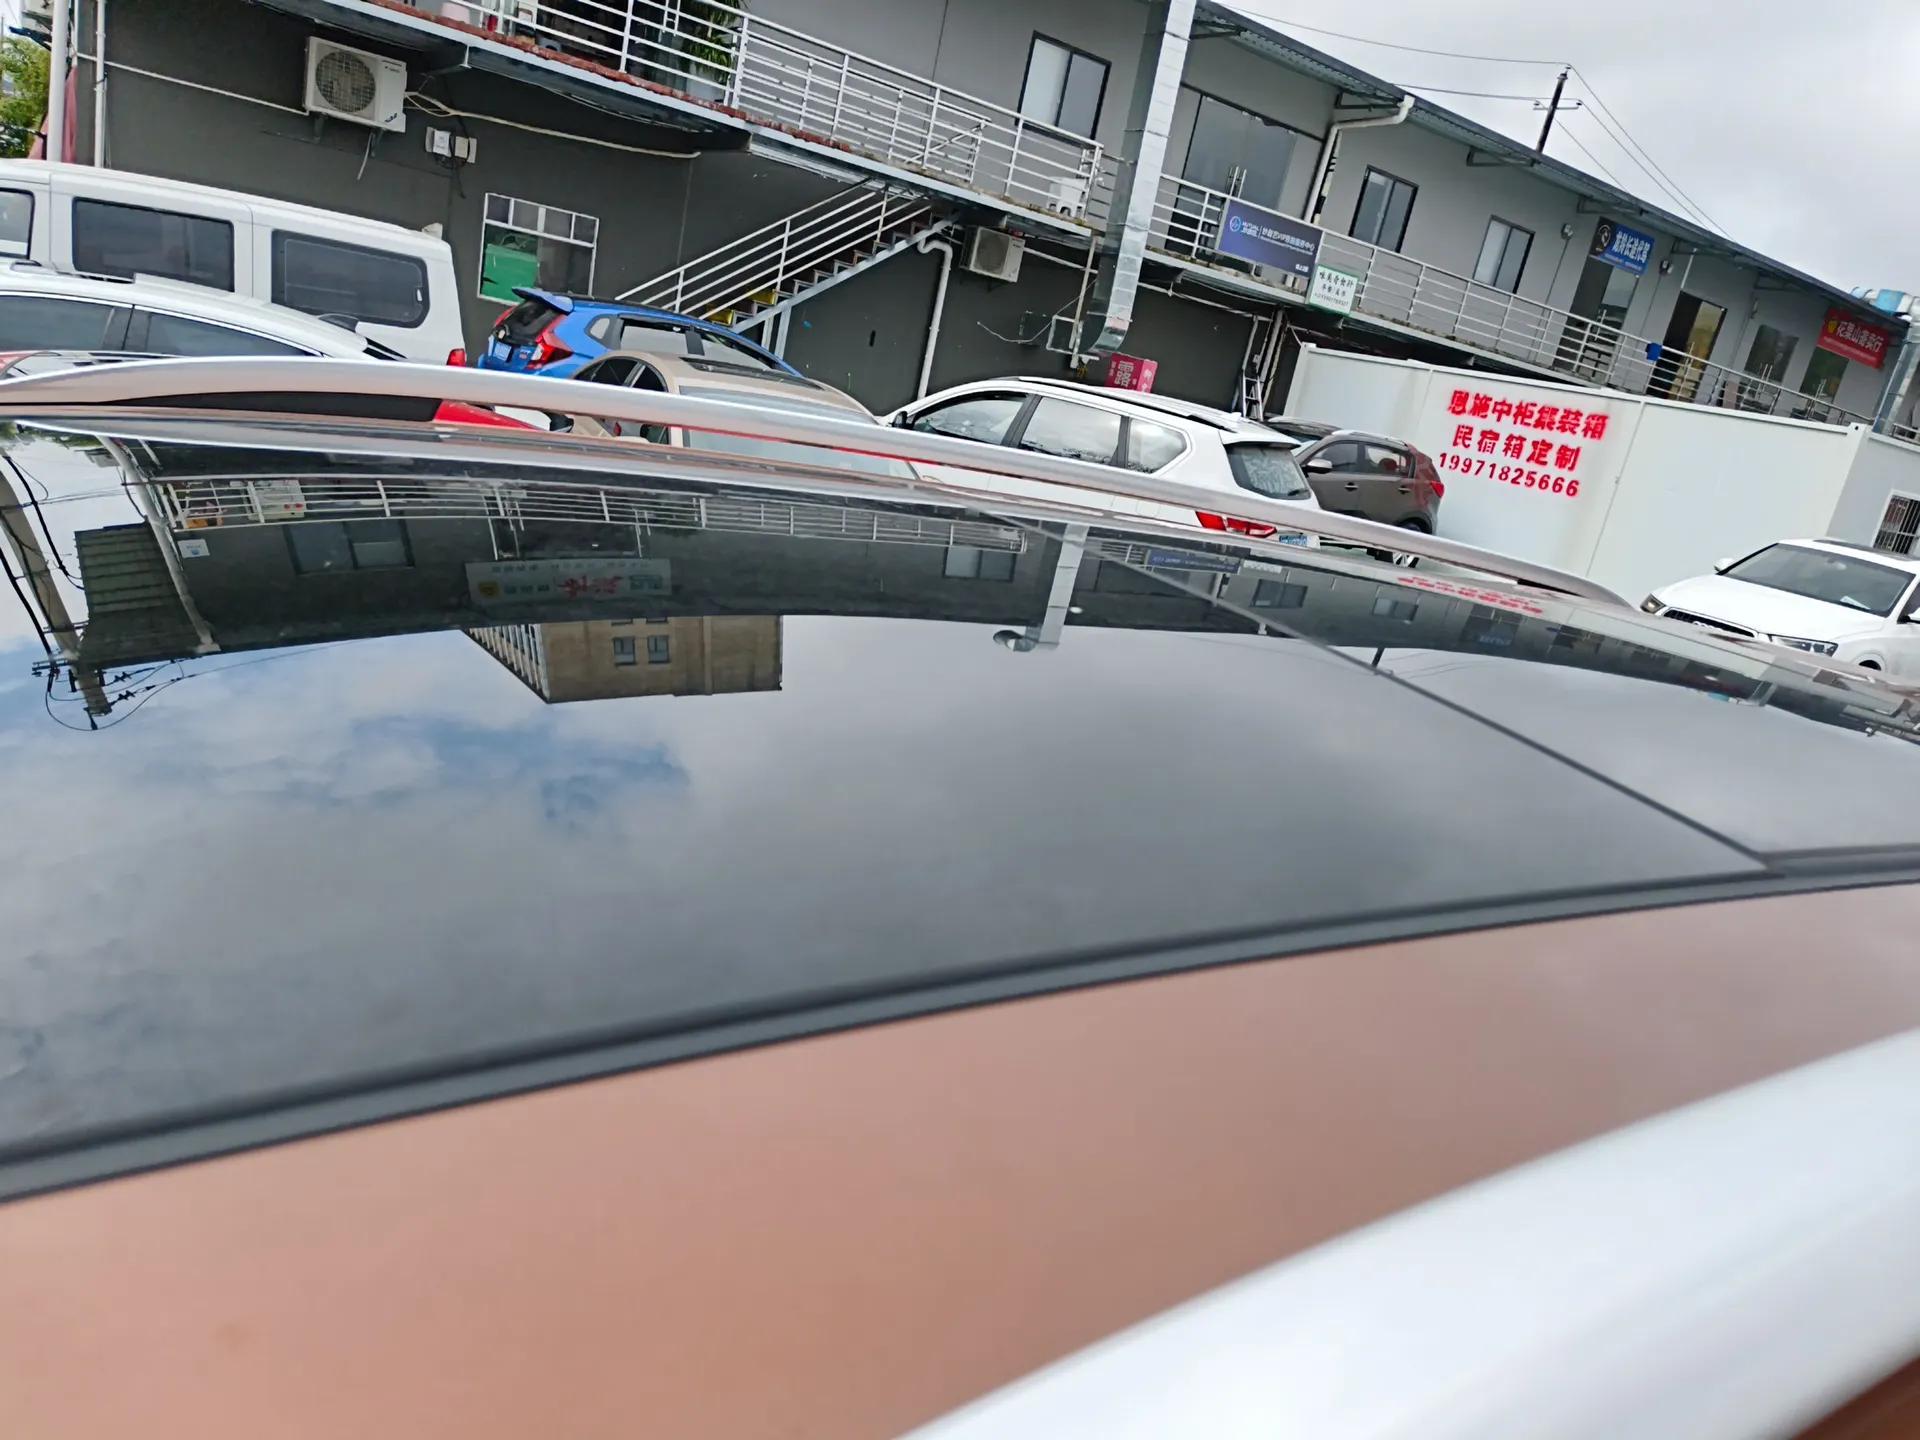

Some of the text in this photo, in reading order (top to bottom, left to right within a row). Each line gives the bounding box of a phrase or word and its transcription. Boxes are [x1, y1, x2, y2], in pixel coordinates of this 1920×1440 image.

[1448, 390, 1609, 440] 恩施中柜集装箱
[1452, 424, 1582, 472] 民宿箱定制
[1439, 452, 1580, 497] 19971825666
